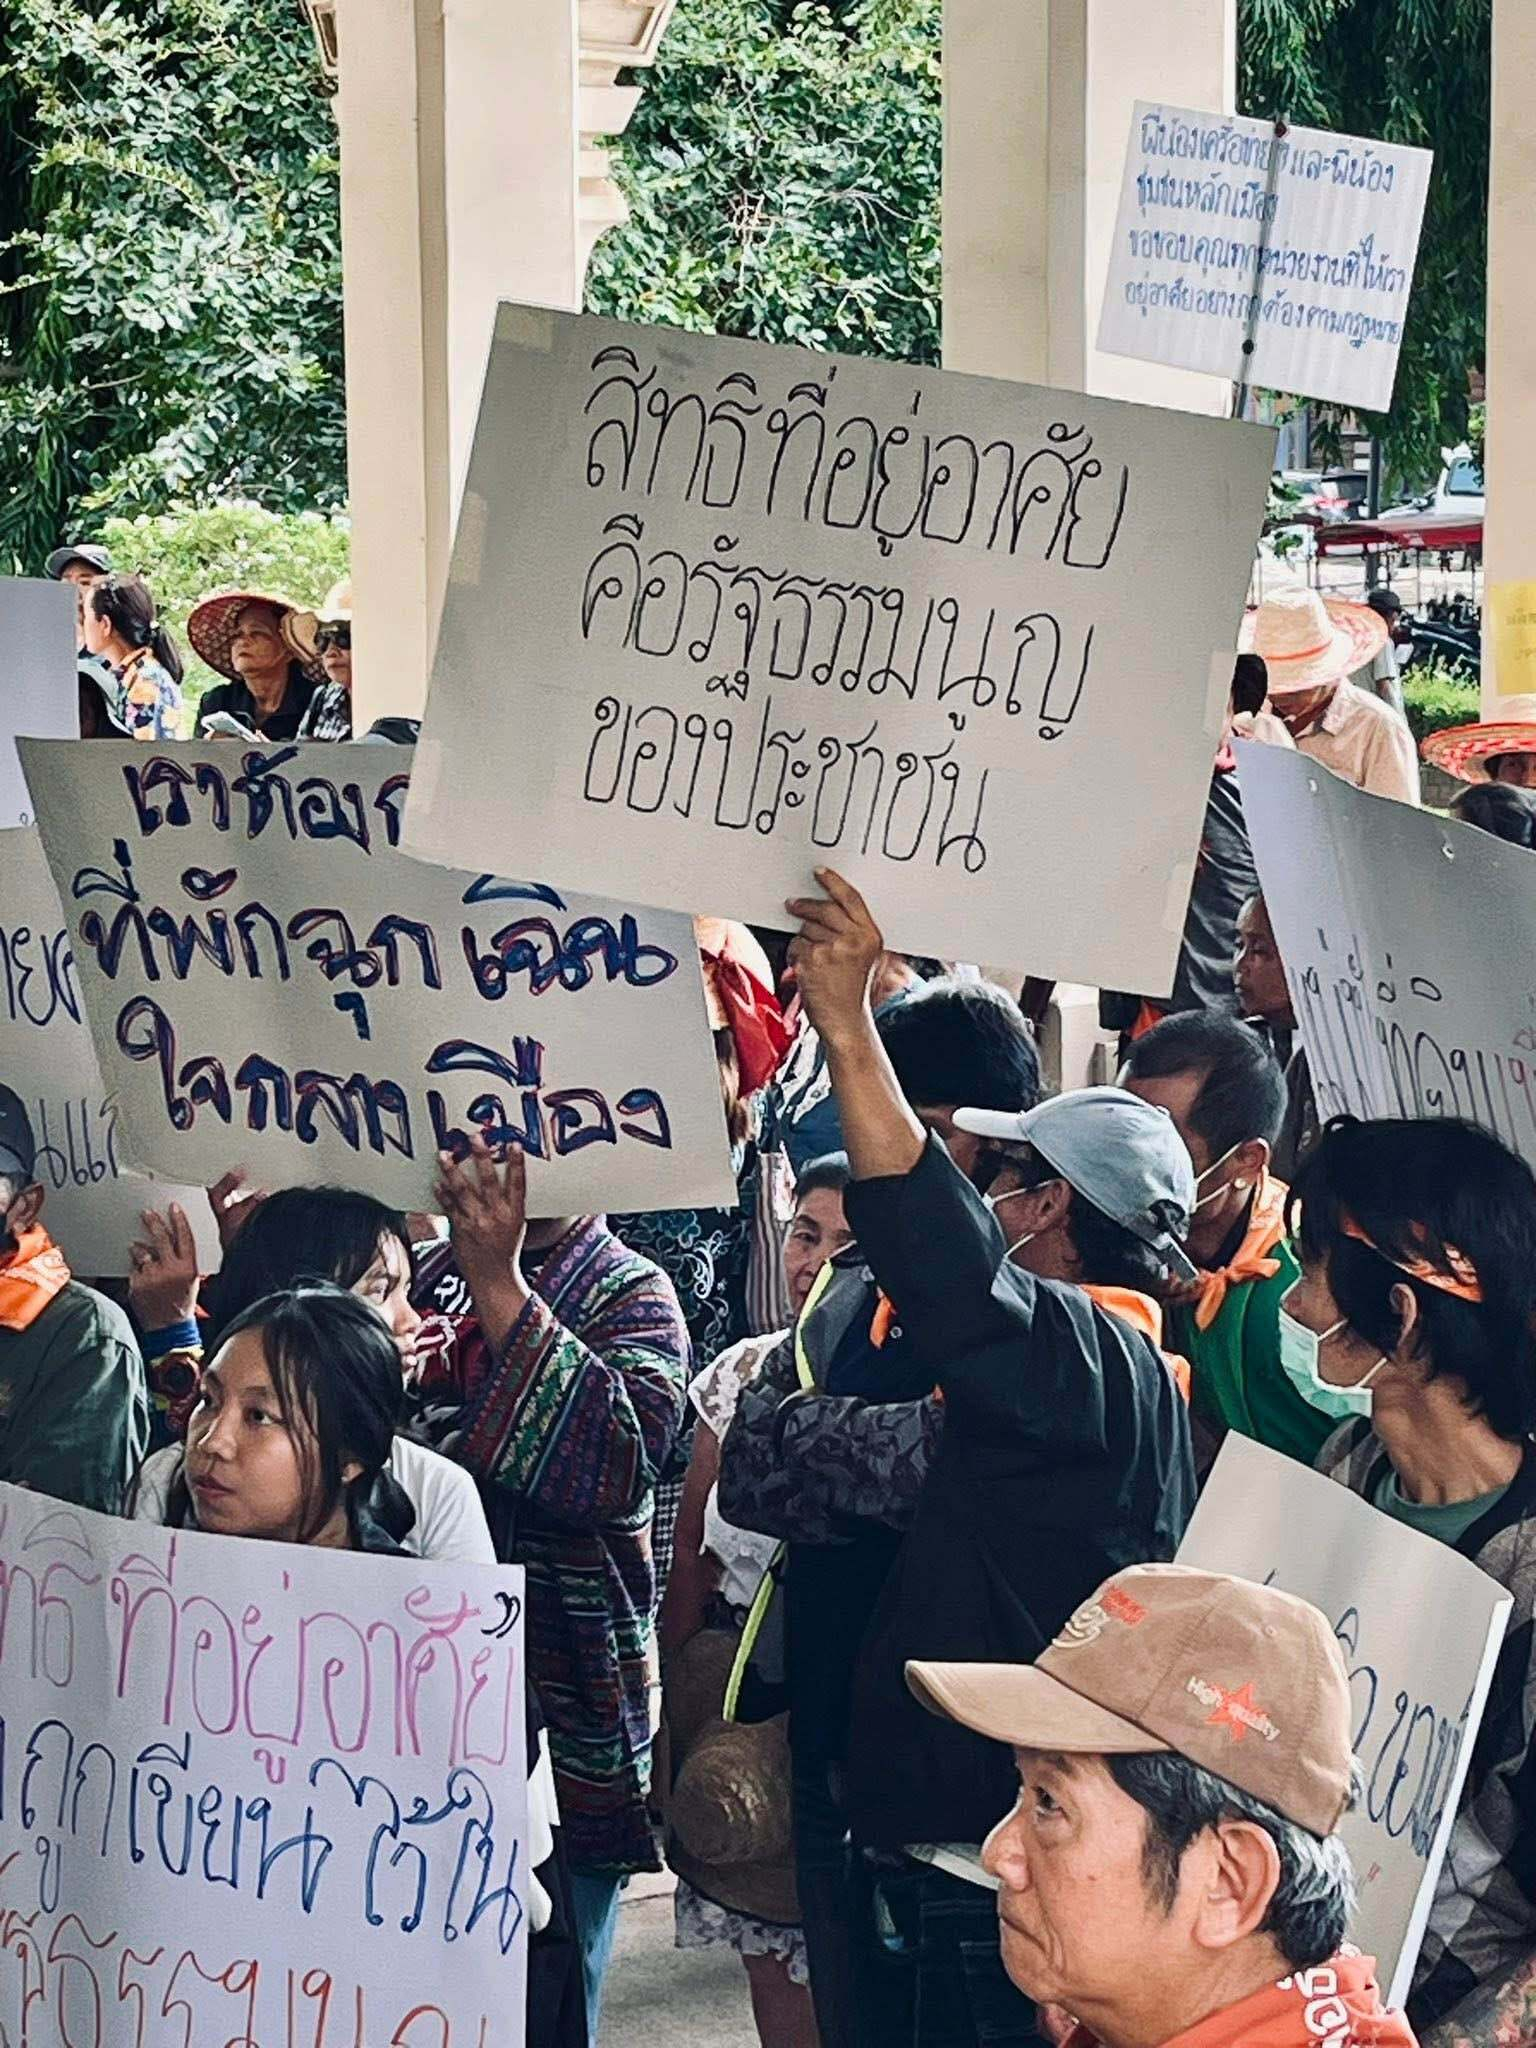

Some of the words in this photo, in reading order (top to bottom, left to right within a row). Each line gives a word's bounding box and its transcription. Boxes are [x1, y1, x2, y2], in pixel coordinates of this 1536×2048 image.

[584, 345, 1128, 569] สิทธิที่อยู่อาศัย
[581, 513, 1094, 740] คือรัฐธรรมนูญ
[583, 695, 988, 873] ของประชาชน
[116, 995, 672, 1161] ใจกลางเมือง
